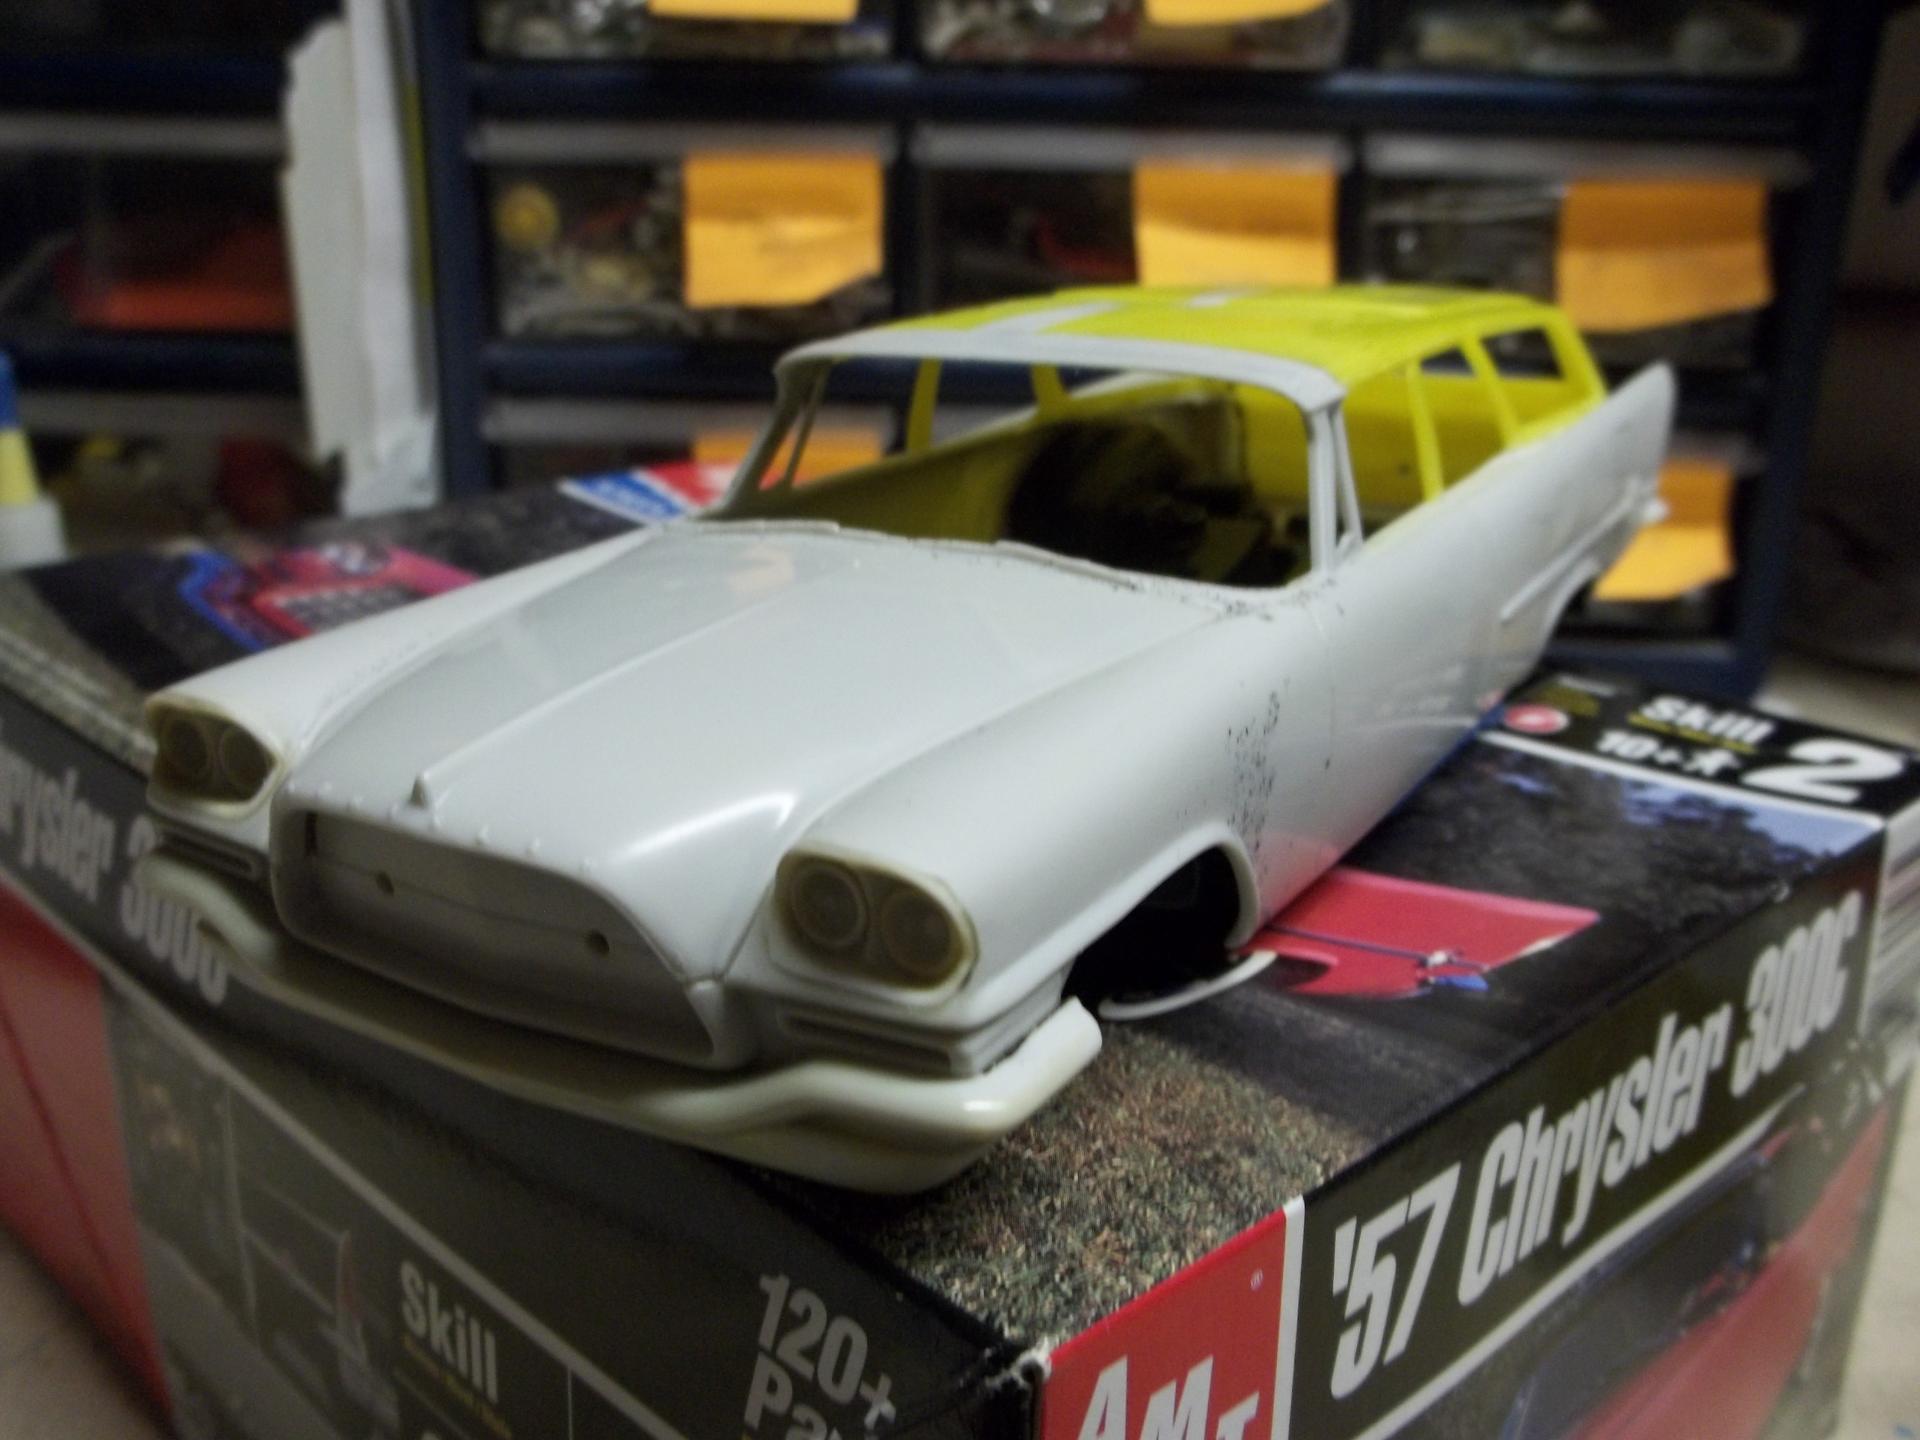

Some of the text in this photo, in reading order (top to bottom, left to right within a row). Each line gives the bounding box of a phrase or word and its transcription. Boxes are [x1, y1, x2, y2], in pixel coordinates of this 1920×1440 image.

[1741, 738, 1904, 802] 2
[1331, 888, 1862, 1399] '57 Chrysler 300C
[401, 1261, 498, 1404] Skill
[758, 1274, 897, 1431] 120+
